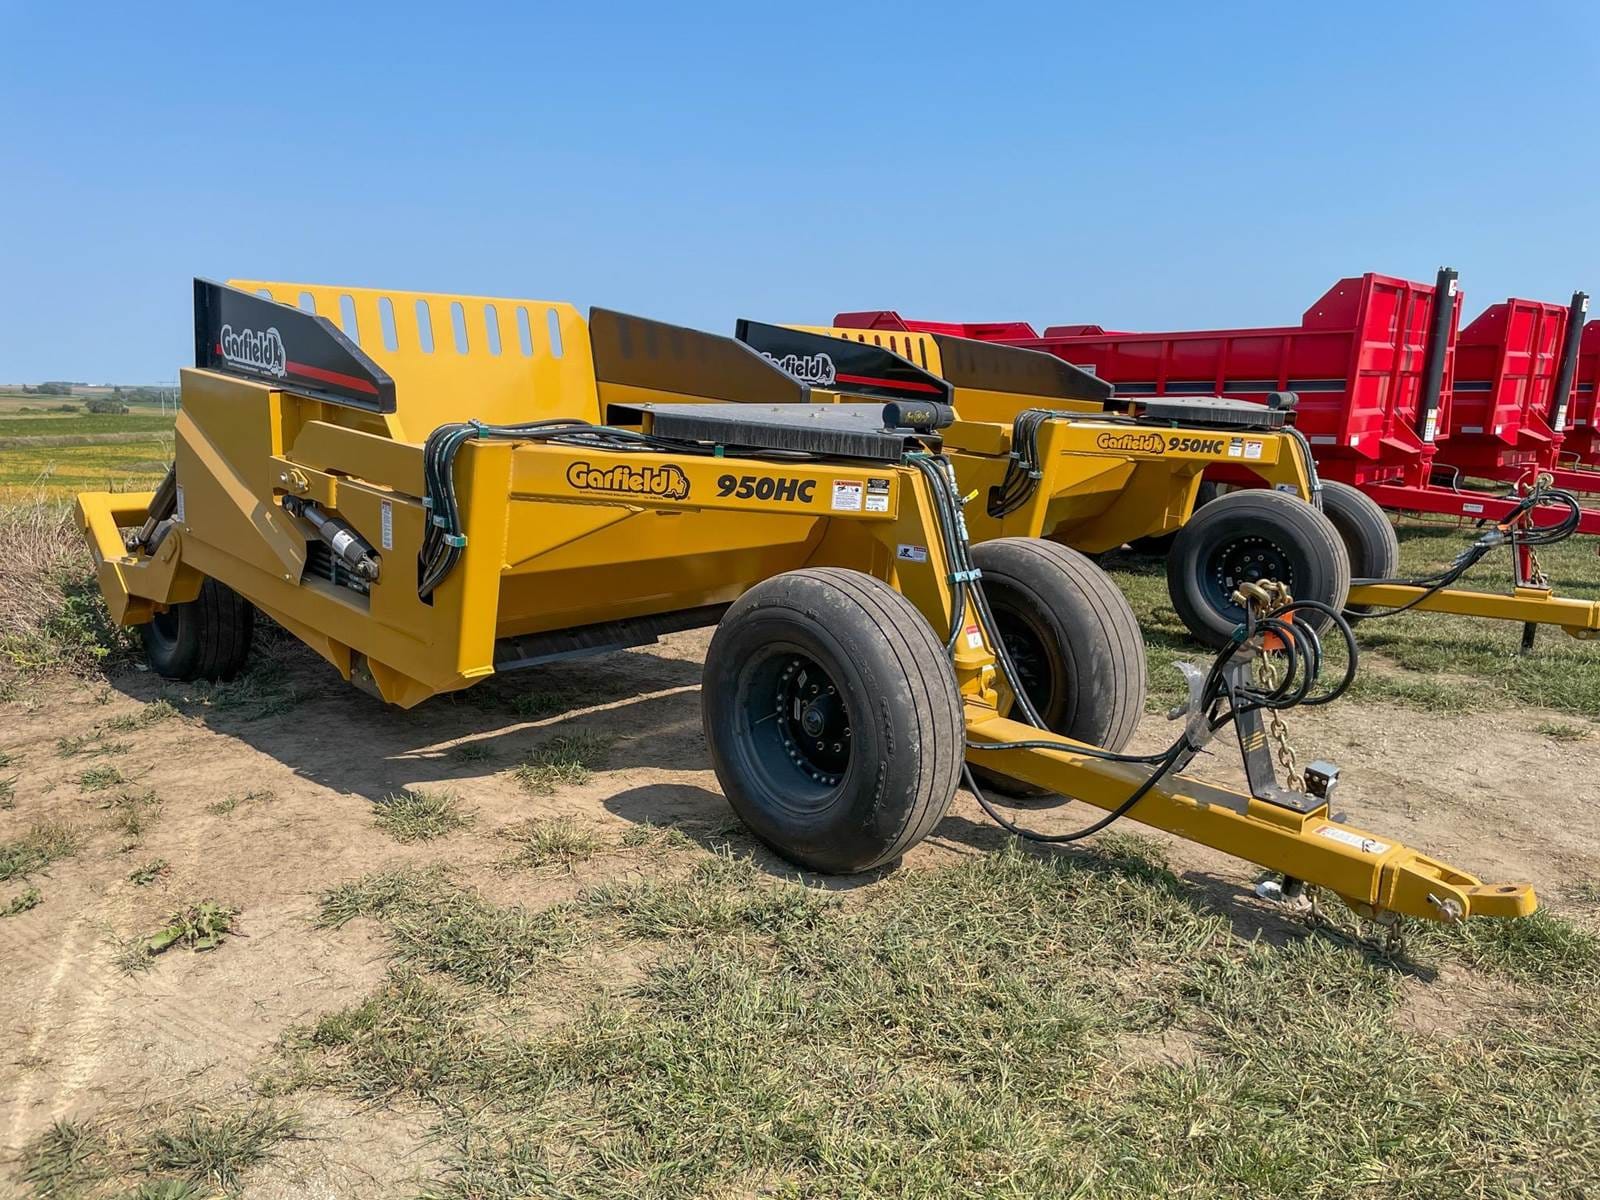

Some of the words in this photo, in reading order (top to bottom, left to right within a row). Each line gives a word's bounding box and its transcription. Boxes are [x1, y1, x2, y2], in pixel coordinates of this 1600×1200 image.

[220, 324, 274, 370] Garfield
[1097, 433, 1155, 452] Garfield
[1168, 437, 1224, 454] 950HC
[566, 461, 670, 495] Garfield
[716, 474, 817, 503] 950HC
